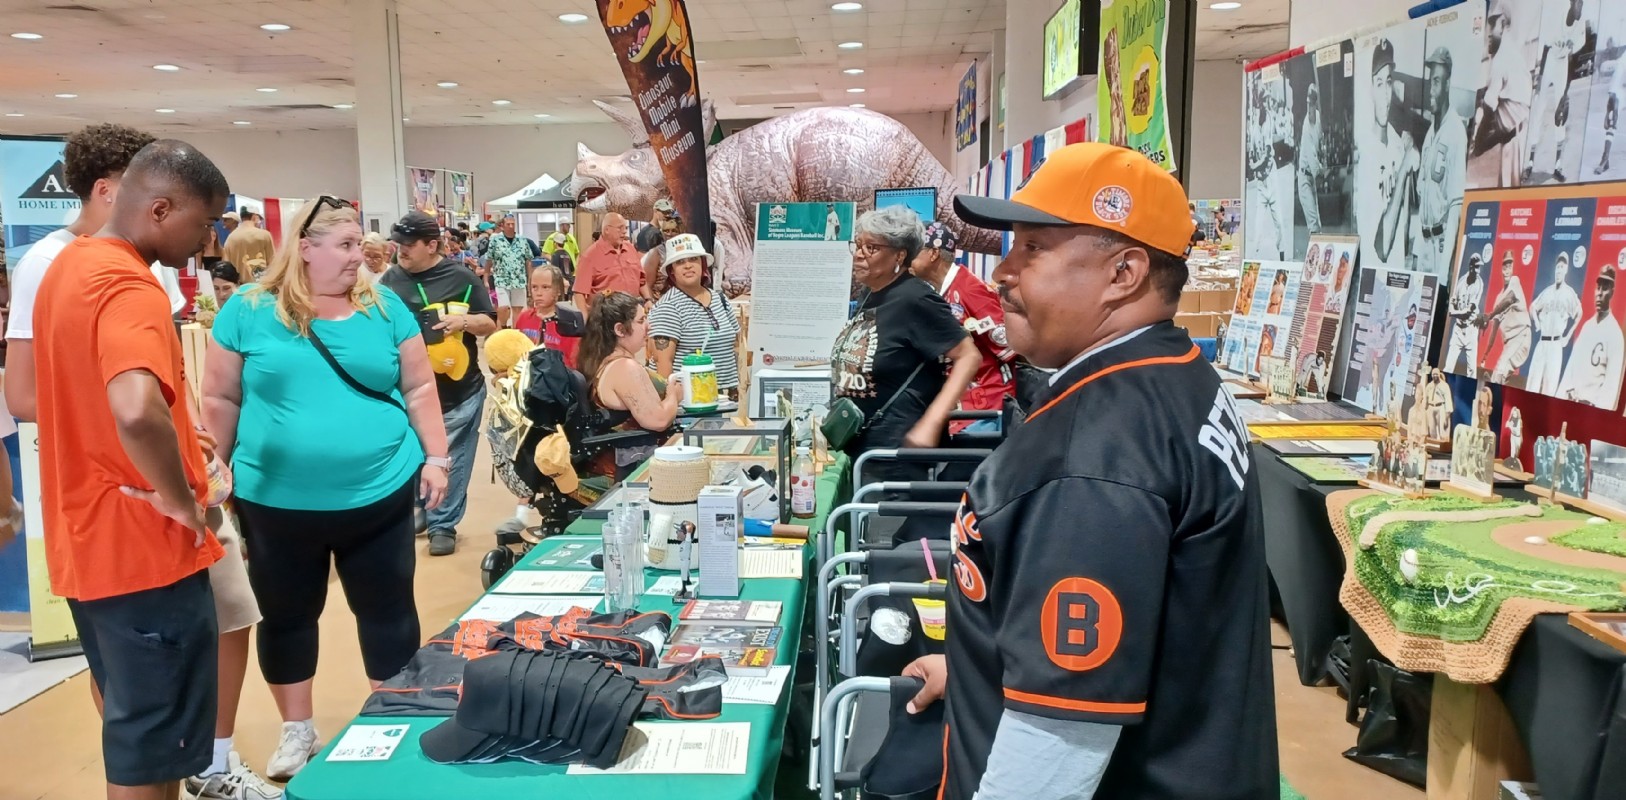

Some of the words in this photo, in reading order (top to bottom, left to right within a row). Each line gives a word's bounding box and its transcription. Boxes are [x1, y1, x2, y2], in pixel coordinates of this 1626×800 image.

[638, 73, 673, 110] Dinosaur
[648, 94, 677, 126] Mobile
[660, 113, 681, 141] Mini
[660, 131, 696, 166] Museum
[19, 201, 58, 209] HOME
[862, 325, 878, 373] BASEBALL
[1056, 591, 1100, 657] B
